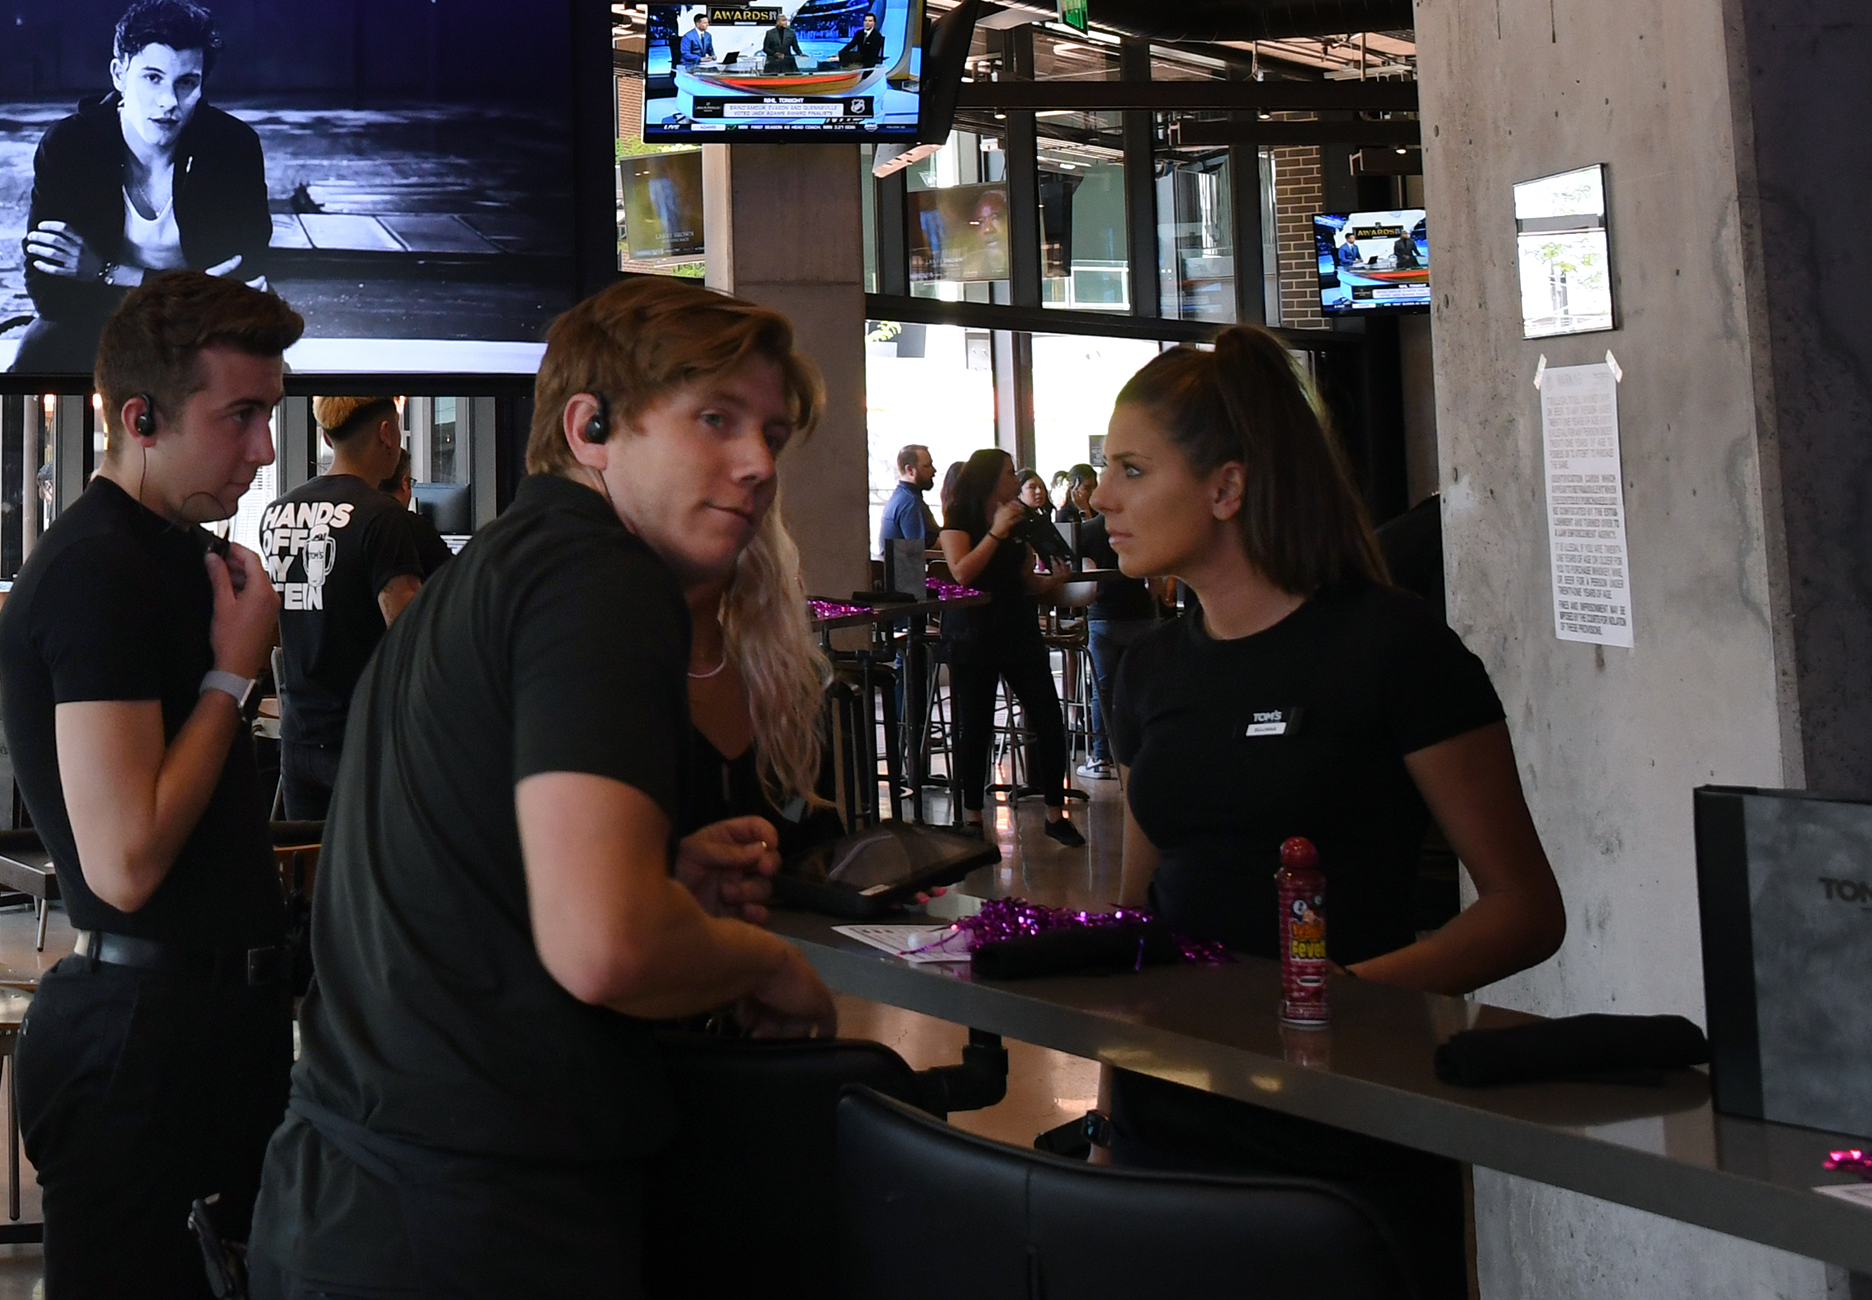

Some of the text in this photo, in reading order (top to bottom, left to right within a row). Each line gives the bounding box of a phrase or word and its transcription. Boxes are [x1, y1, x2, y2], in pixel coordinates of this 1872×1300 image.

[713, 10, 769, 20] AWARDS
[262, 502, 355, 531] HANDS
[263, 528, 309, 557] OFF
